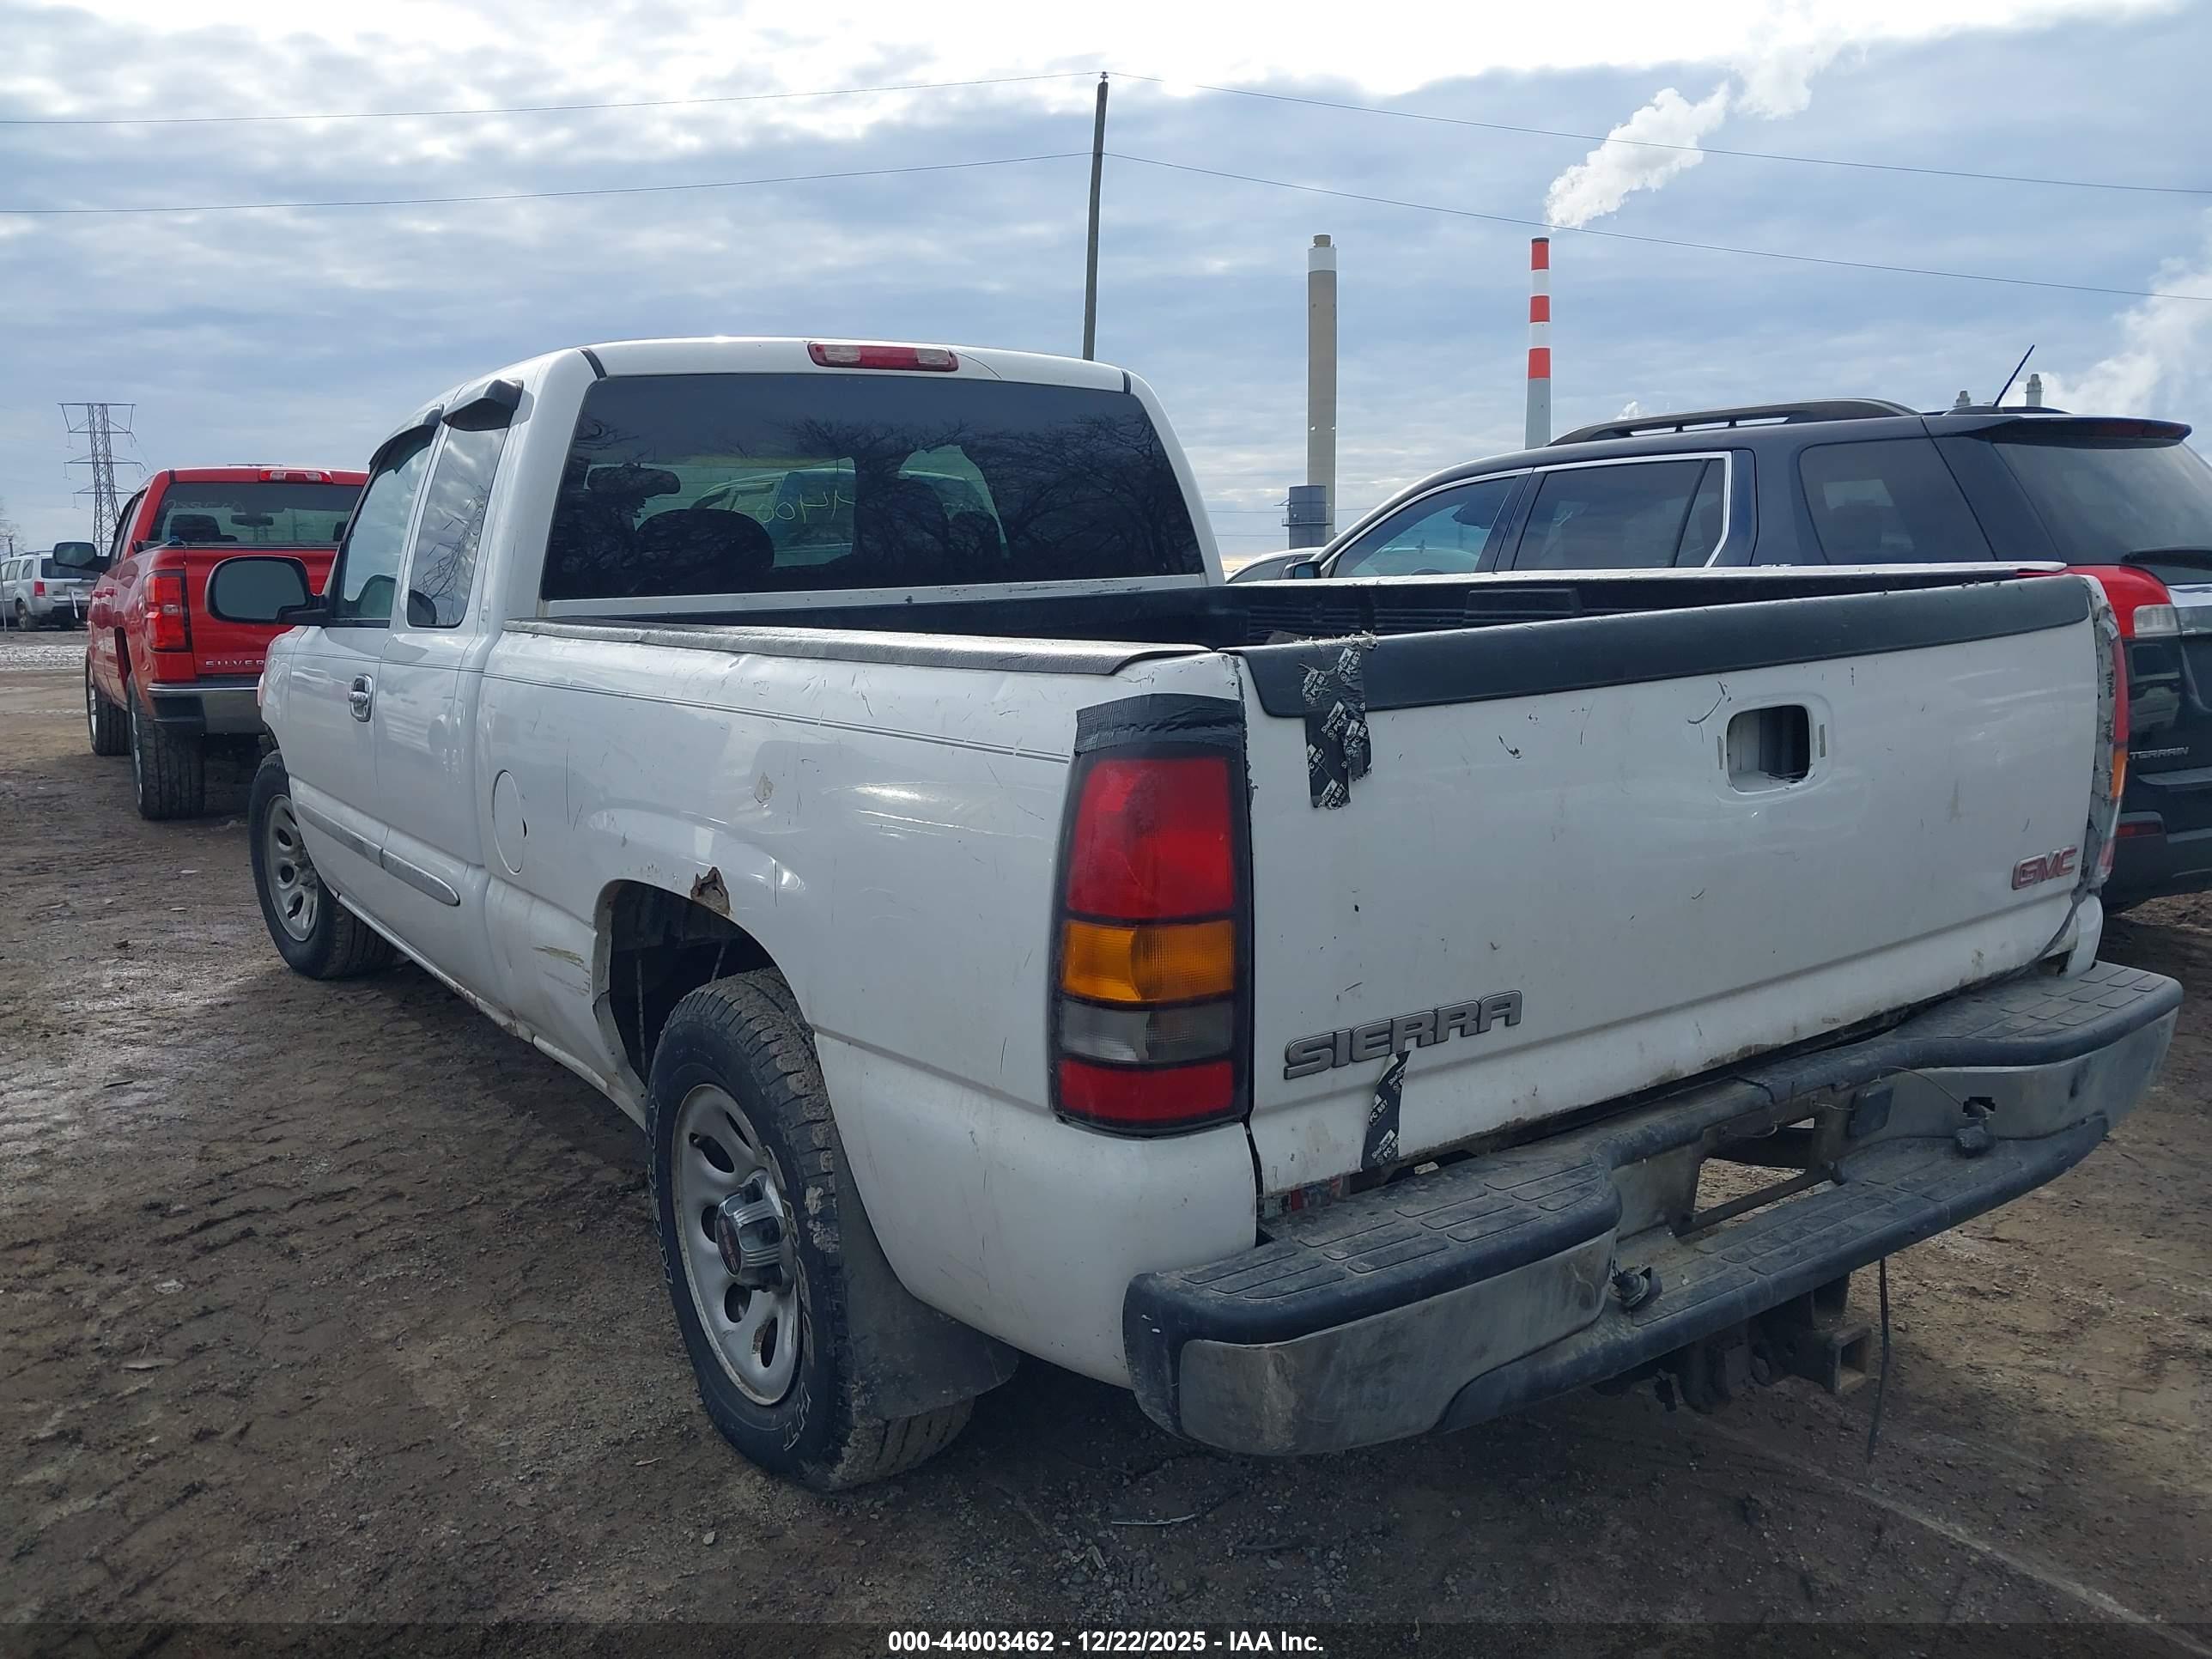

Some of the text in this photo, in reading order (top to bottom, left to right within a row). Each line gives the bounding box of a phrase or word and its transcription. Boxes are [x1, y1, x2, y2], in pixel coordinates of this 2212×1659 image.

[1333, 719, 1343, 732] PC
[1312, 748, 1324, 763] 857
[2011, 847, 2078, 890] GMC
[1283, 989, 1523, 1081] SIERRA
[1376, 1099, 1388, 1114] 857
[1382, 1146, 1392, 1158] PC
